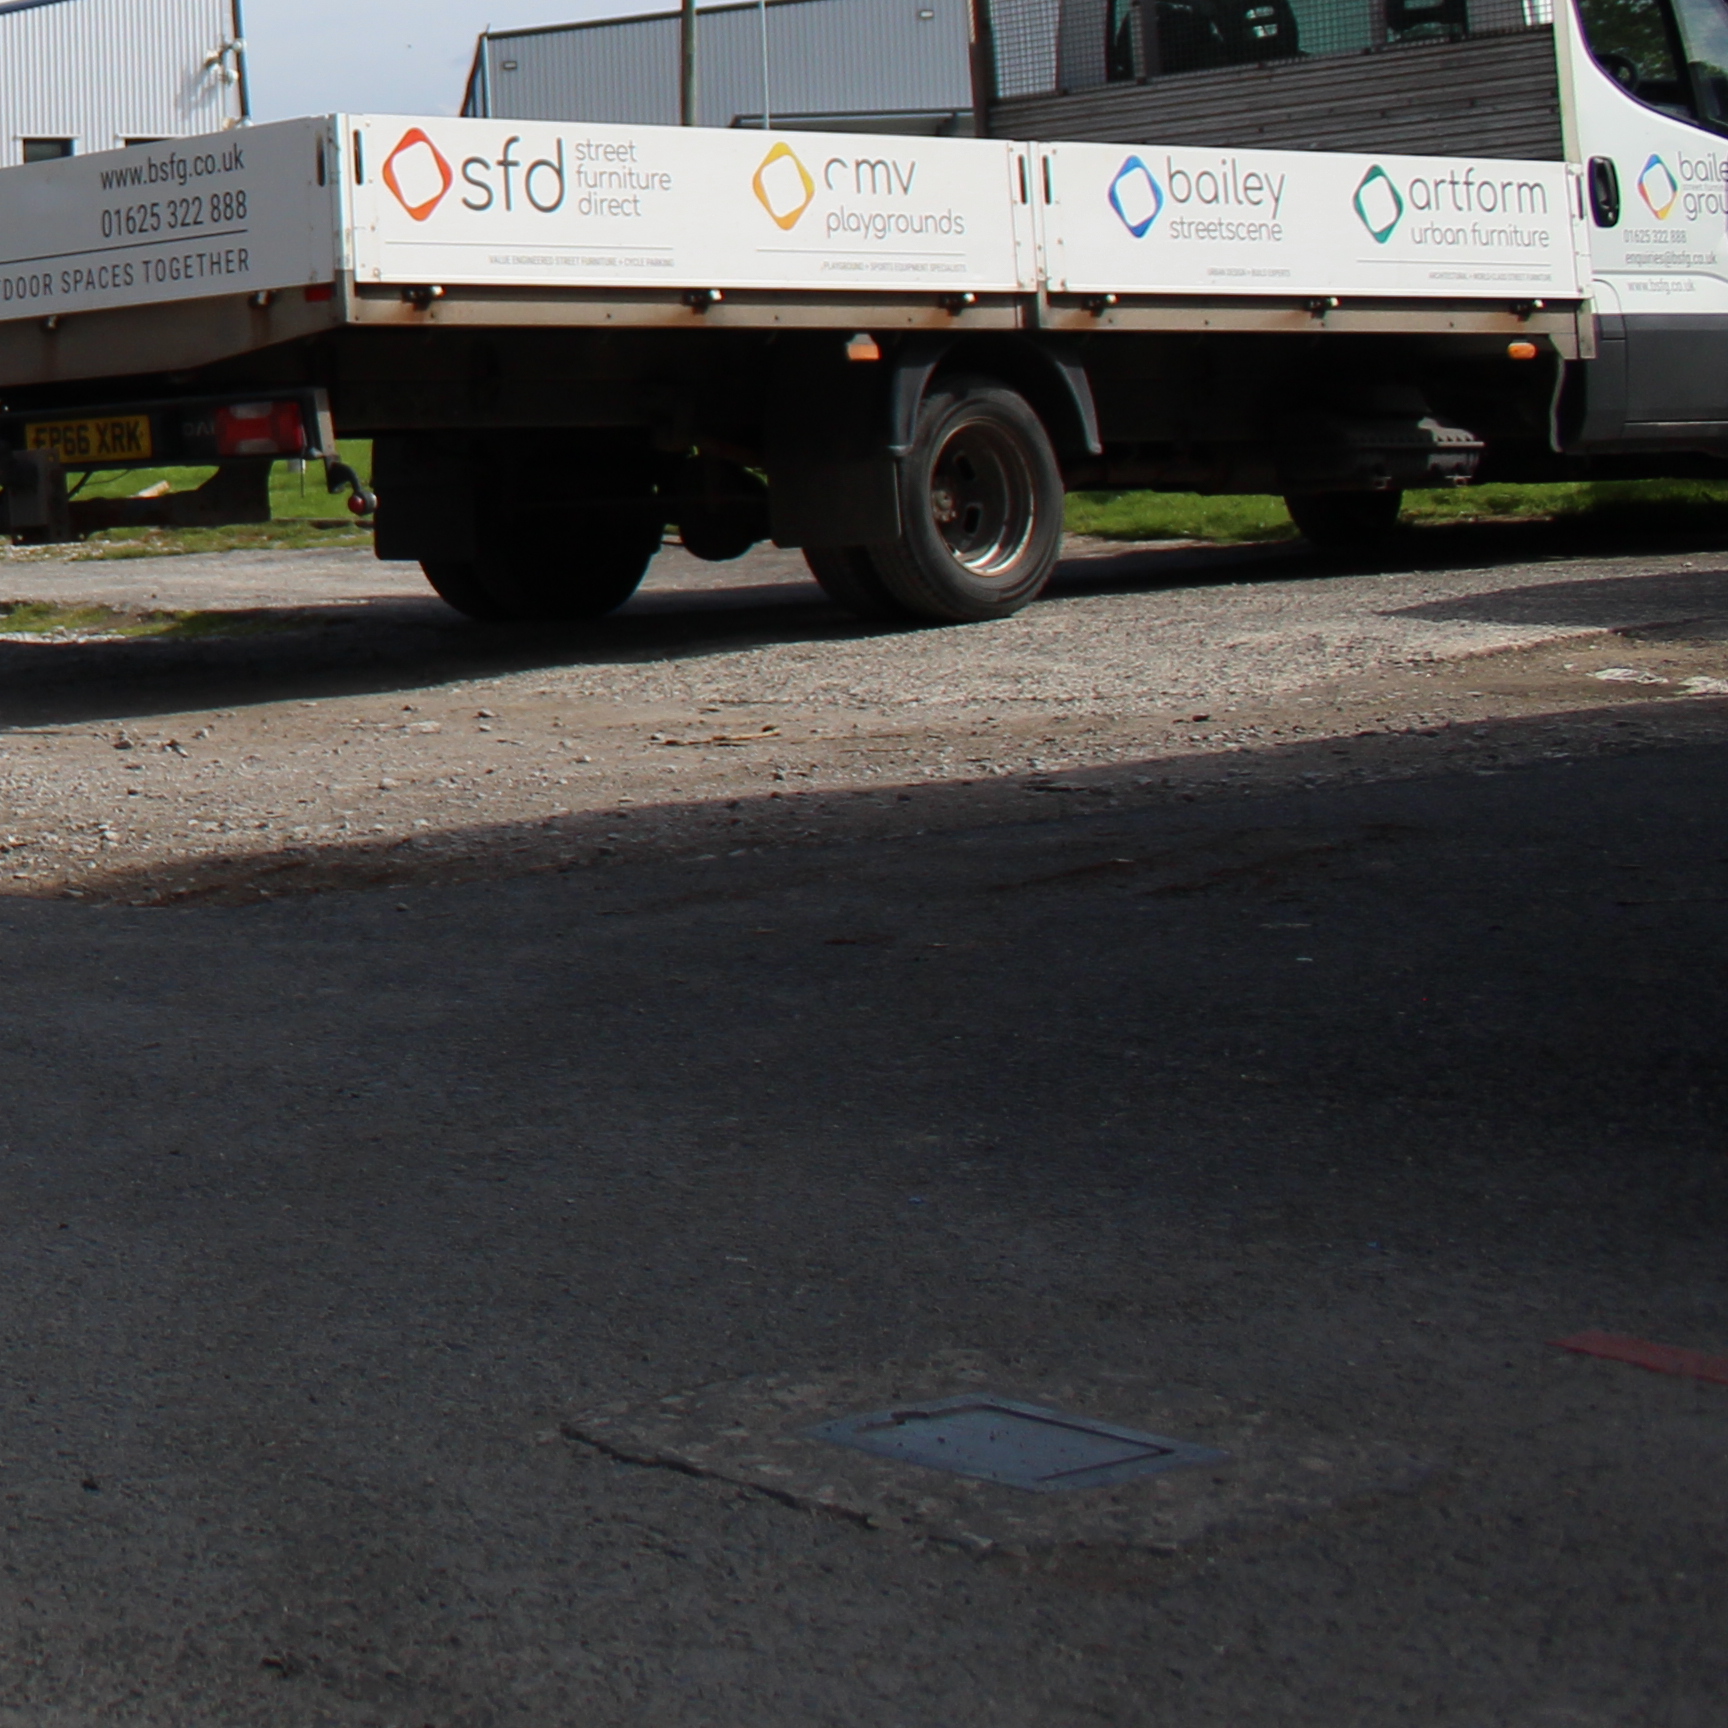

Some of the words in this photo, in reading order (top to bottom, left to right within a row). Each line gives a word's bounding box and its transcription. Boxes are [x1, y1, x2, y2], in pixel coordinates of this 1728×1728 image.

[575, 138, 638, 162] street
[100, 142, 245, 190] www.bsfg.co.uk
[461, 135, 567, 213] sfd
[575, 163, 672, 191] furniture
[1166, 155, 1285, 220] bailey
[1409, 166, 1547, 214] artform
[102, 202, 161, 238] 01625
[167, 196, 204, 229] 322
[210, 189, 248, 223] 888
[578, 191, 642, 217] direct
[826, 204, 966, 239] playgrounds
[1169, 216, 1283, 241] streetscene
[1410, 220, 1468, 245] urban
[1471, 221, 1550, 247] furniture
[1623, 229, 1651, 244] 01625
[1652, 229, 1669, 244] 322
[1670, 229, 1687, 244] 888
[61, 262, 134, 294] SPACES
[141, 248, 250, 283] TOGETHER
[1625, 250, 1717, 268] enquiries@bsfg.co.uk
[1627, 278, 1696, 295] www.bsfg.co.uk
[95, 420, 142, 454] XRK
